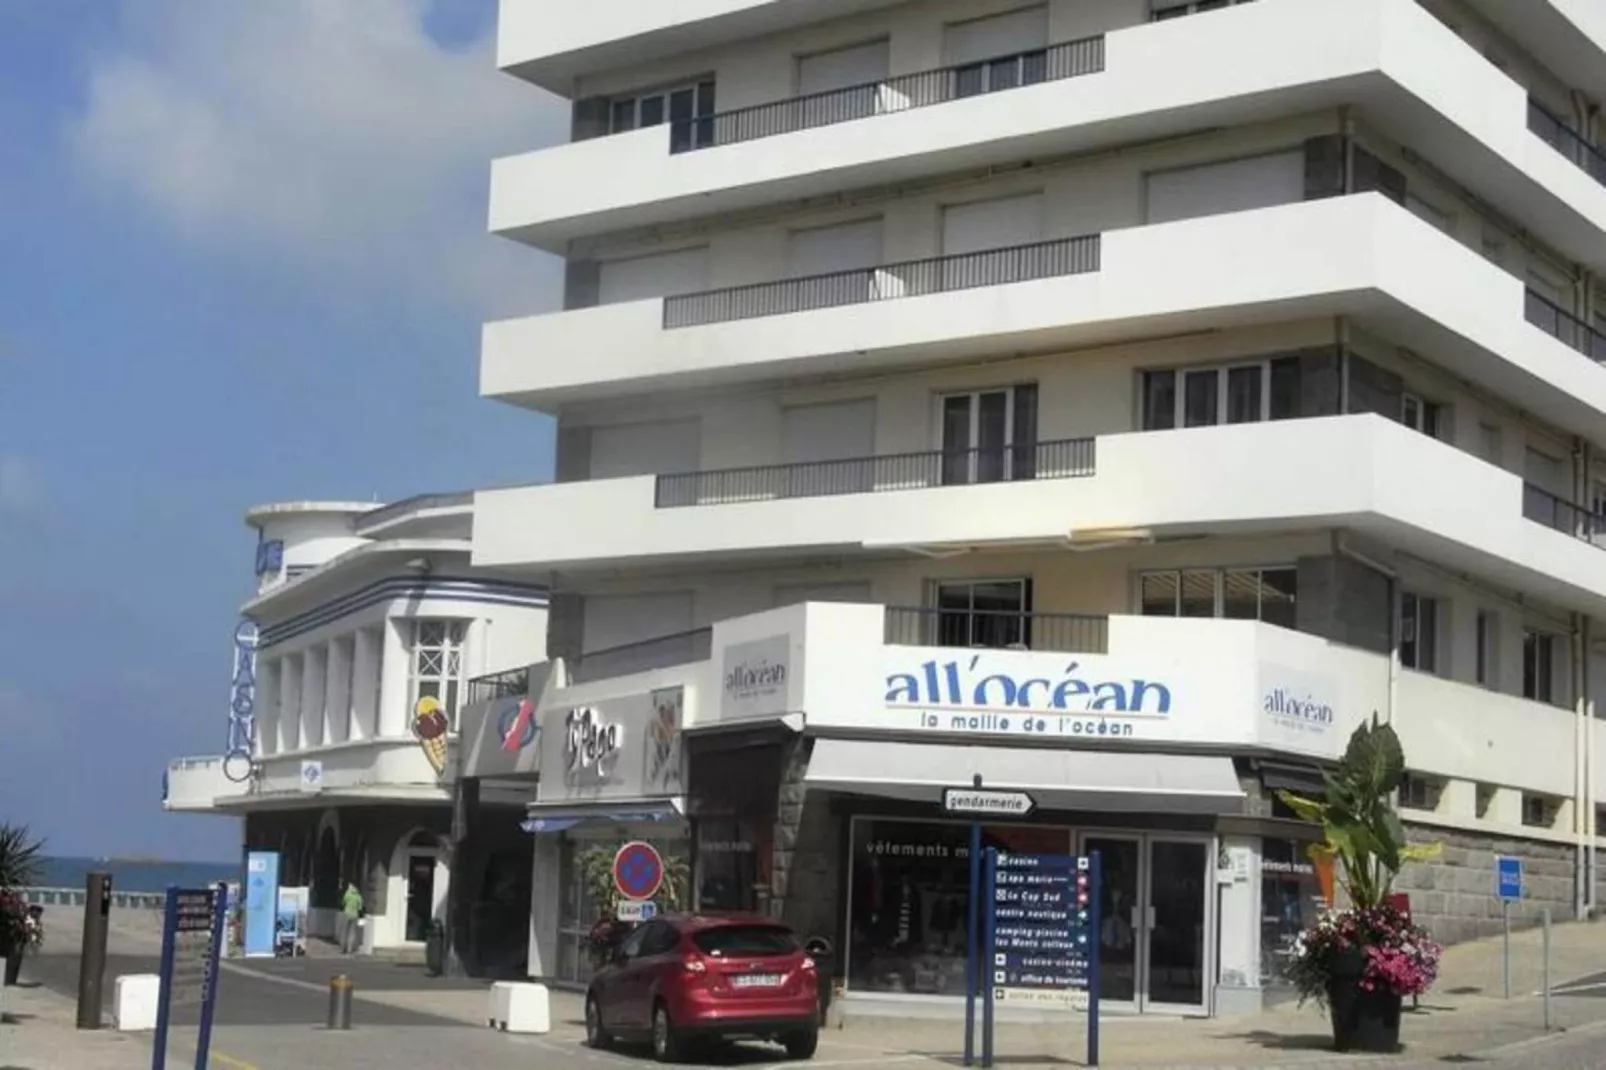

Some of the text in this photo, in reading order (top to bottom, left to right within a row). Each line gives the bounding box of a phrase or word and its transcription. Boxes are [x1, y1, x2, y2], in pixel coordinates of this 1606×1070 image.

[885, 654, 1171, 714] all'océan
[921, 713, 938, 728] la
[1023, 716, 1046, 733] de
[950, 795, 1023, 810] gendarmerie
